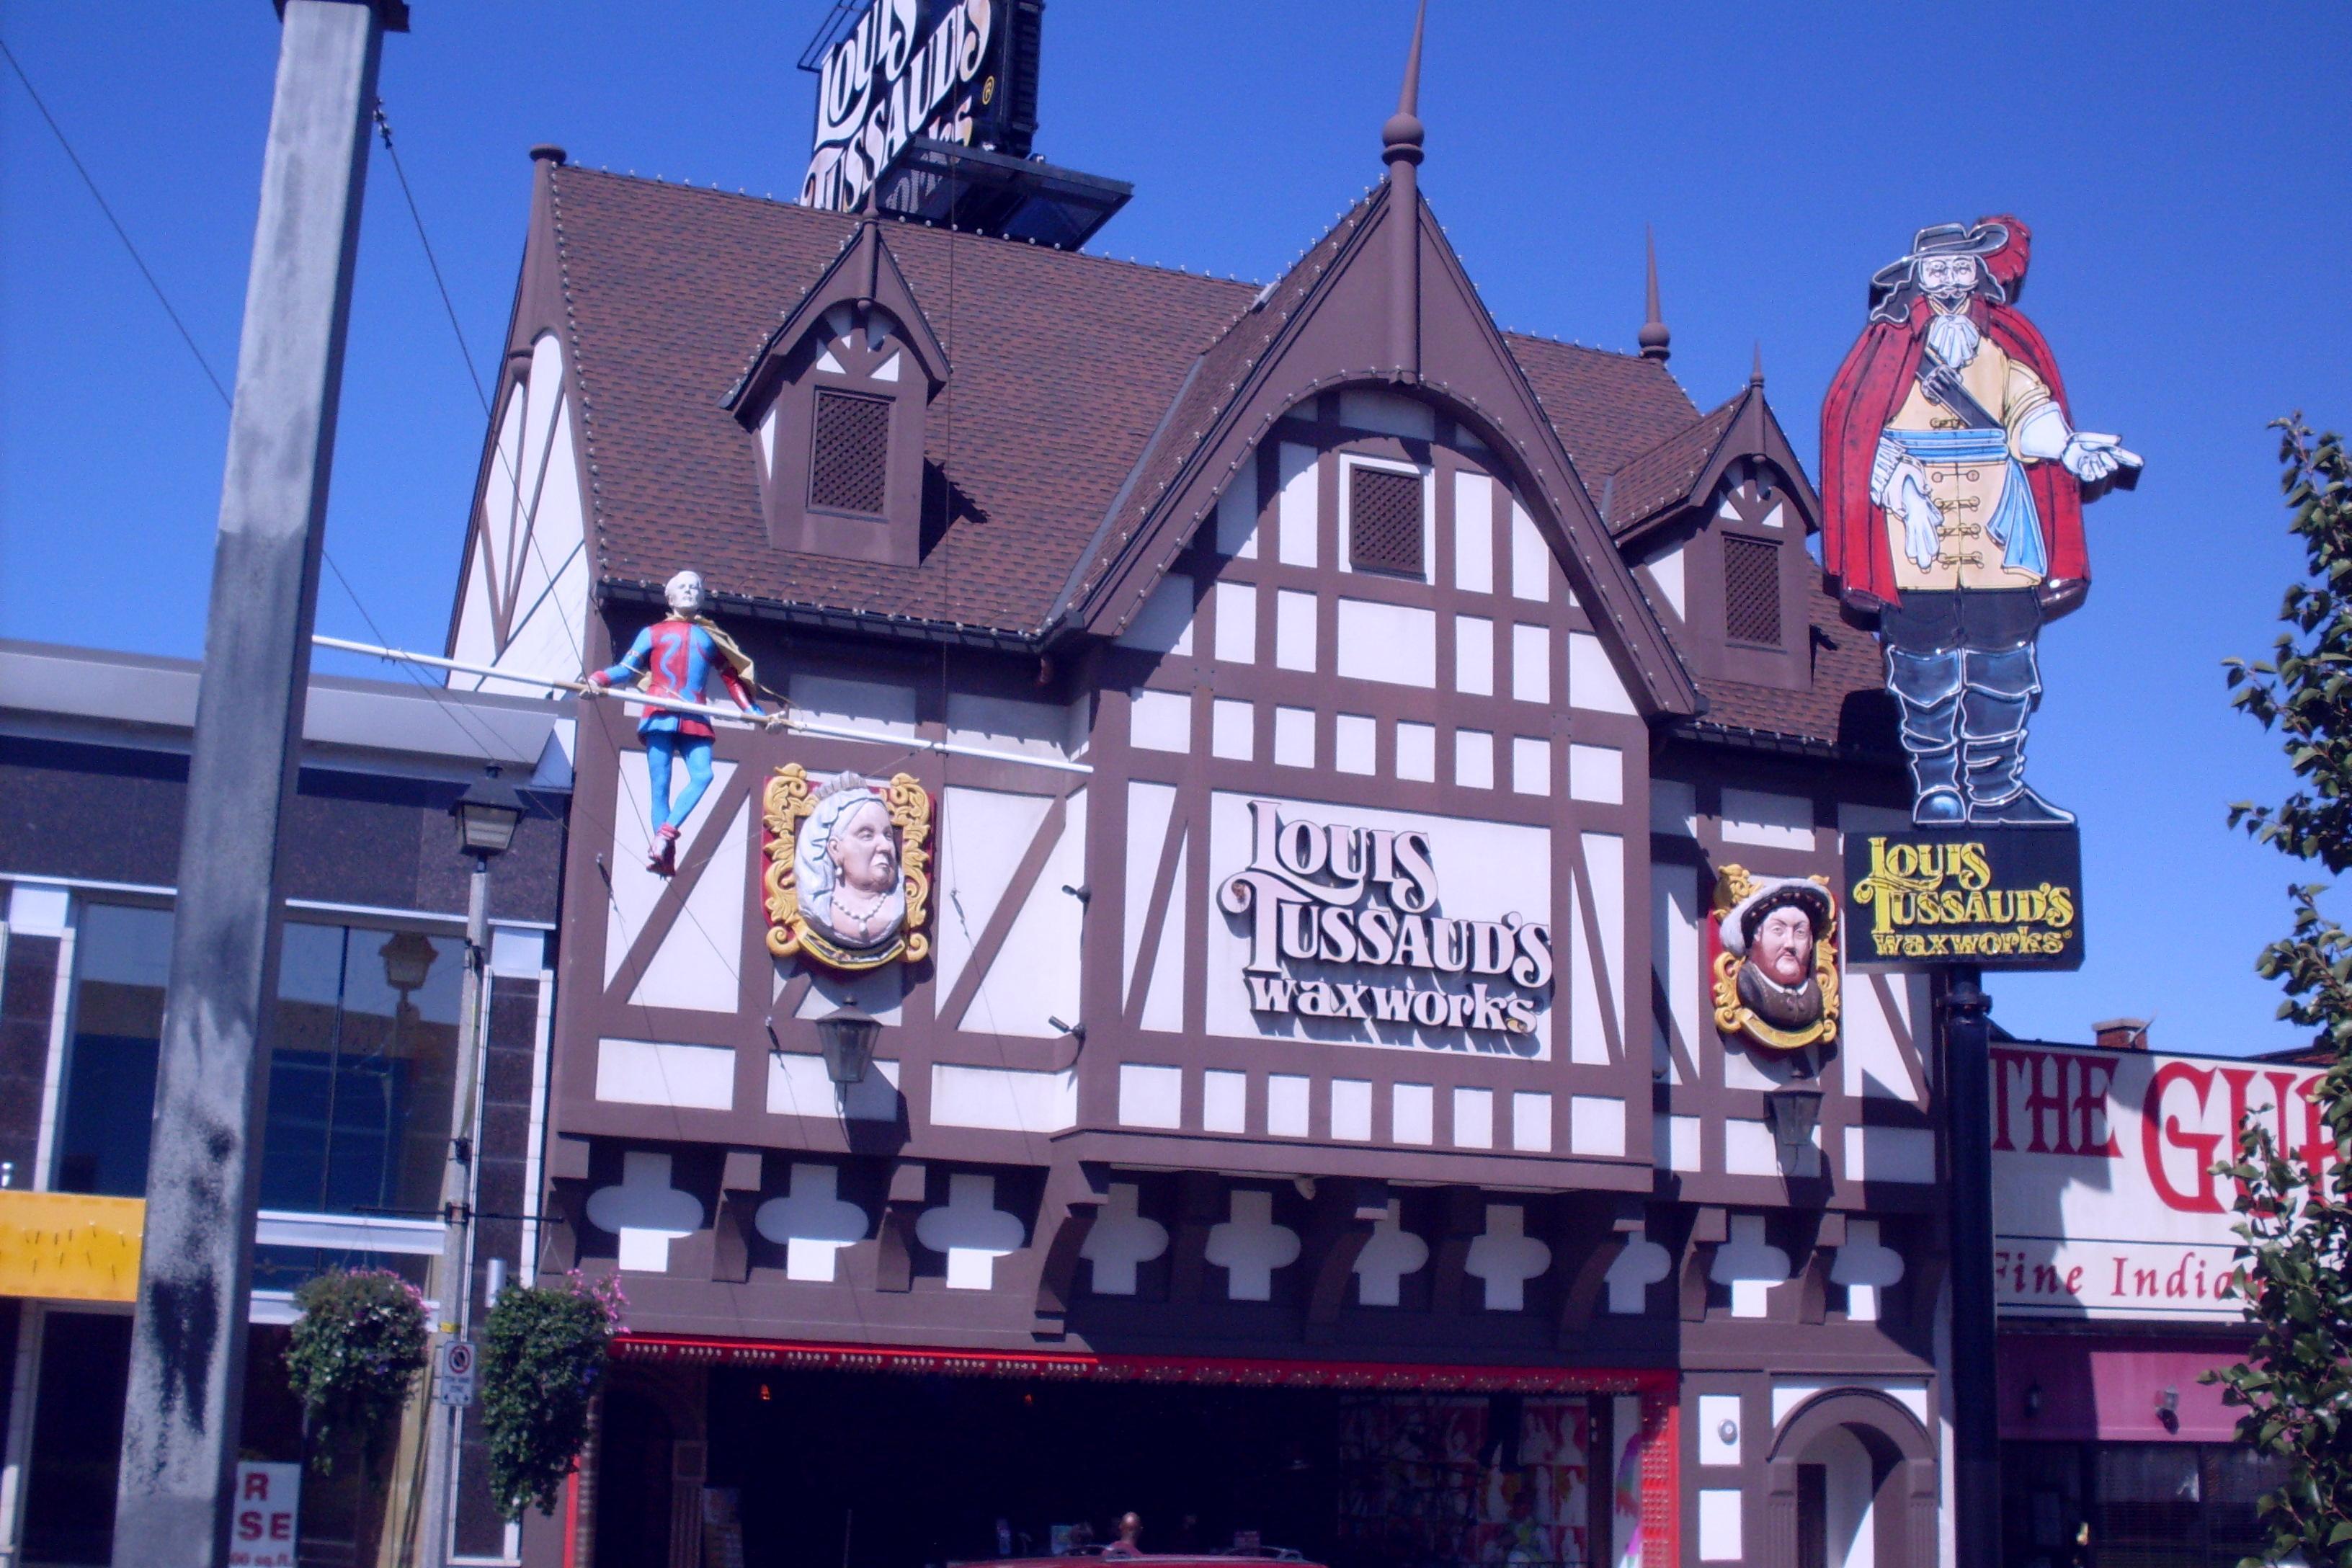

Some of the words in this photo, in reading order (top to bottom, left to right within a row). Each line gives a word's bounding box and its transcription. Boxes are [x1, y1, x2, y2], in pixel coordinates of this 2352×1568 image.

[1247, 800, 1438, 913] LOUIS
[1867, 837, 1991, 891] LOUIS
[1220, 870, 1553, 989] TUSSAUD'S
[1853, 877, 2075, 935] TUSSAUD'S
[1247, 976, 1538, 1035] waxworks
[1990, 1048, 2124, 1159] THE
